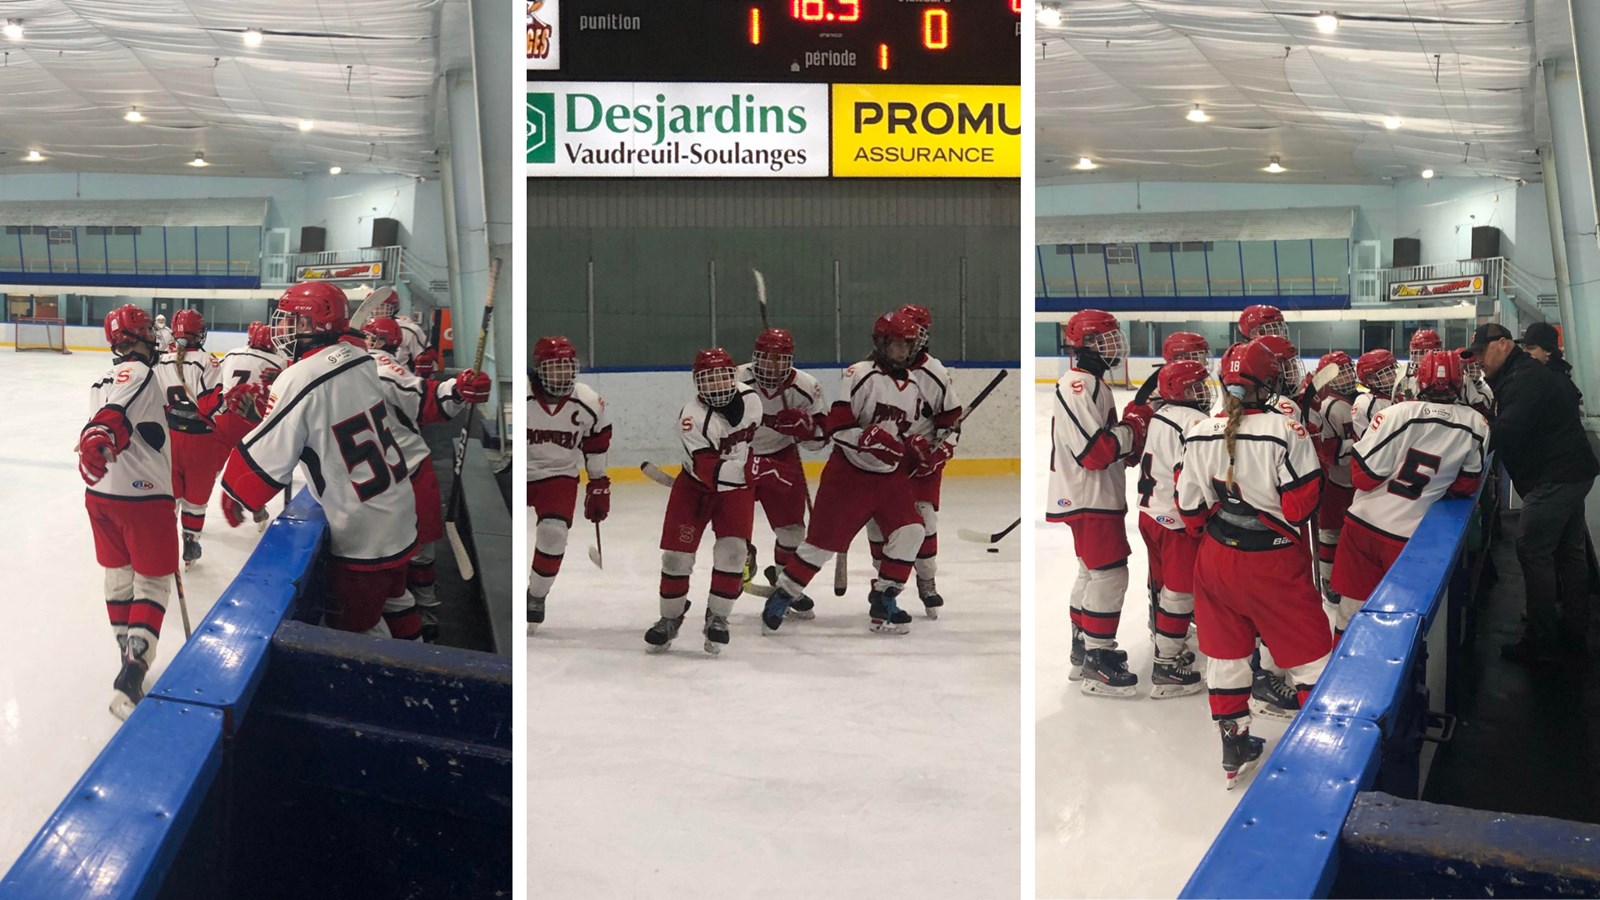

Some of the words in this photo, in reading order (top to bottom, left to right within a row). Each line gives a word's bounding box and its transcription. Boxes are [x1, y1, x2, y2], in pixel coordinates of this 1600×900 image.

[579, 13, 641, 31] punition
[924, 8, 949, 49] 0
[804, 49, 857, 69] période
[565, 93, 808, 146] Desjardins
[854, 101, 1021, 135] PROMU
[564, 141, 808, 172] Vaudreuil-Soulanges
[853, 146, 994, 163] ASSURANCE
[1229, 360, 1241, 373] 18
[115, 369, 131, 385] S
[570, 410, 580, 426] C
[681, 417, 694, 432] S
[1387, 447, 1442, 501] 5
